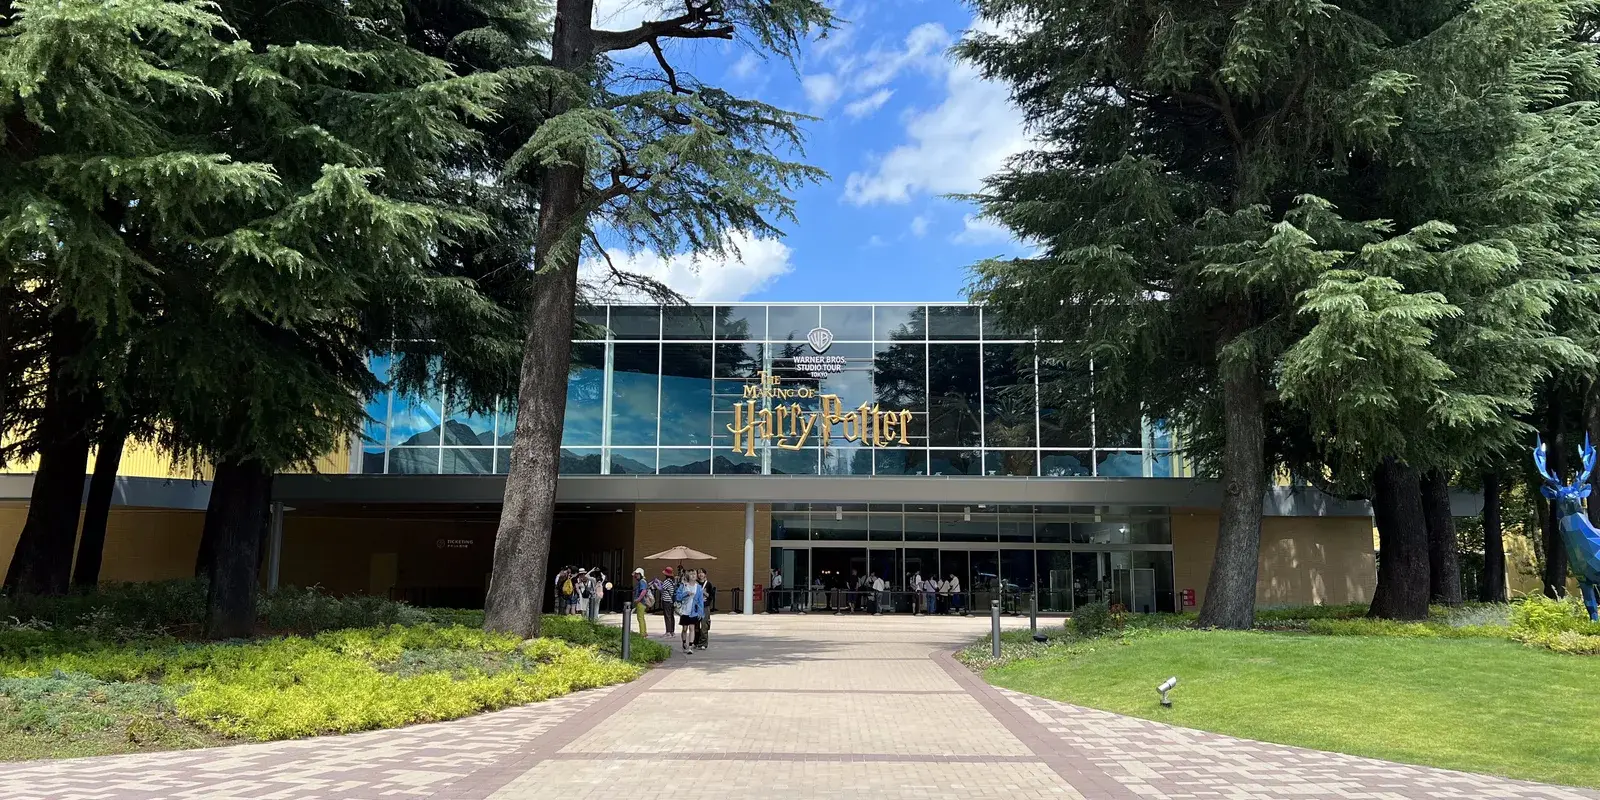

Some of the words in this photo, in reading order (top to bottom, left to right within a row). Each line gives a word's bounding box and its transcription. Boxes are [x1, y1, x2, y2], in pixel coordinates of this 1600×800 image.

[809, 330, 832, 350] WB
[826, 356, 846, 364] BROS.
[726, 399, 818, 457] Harry
[820, 394, 913, 455] Potter
